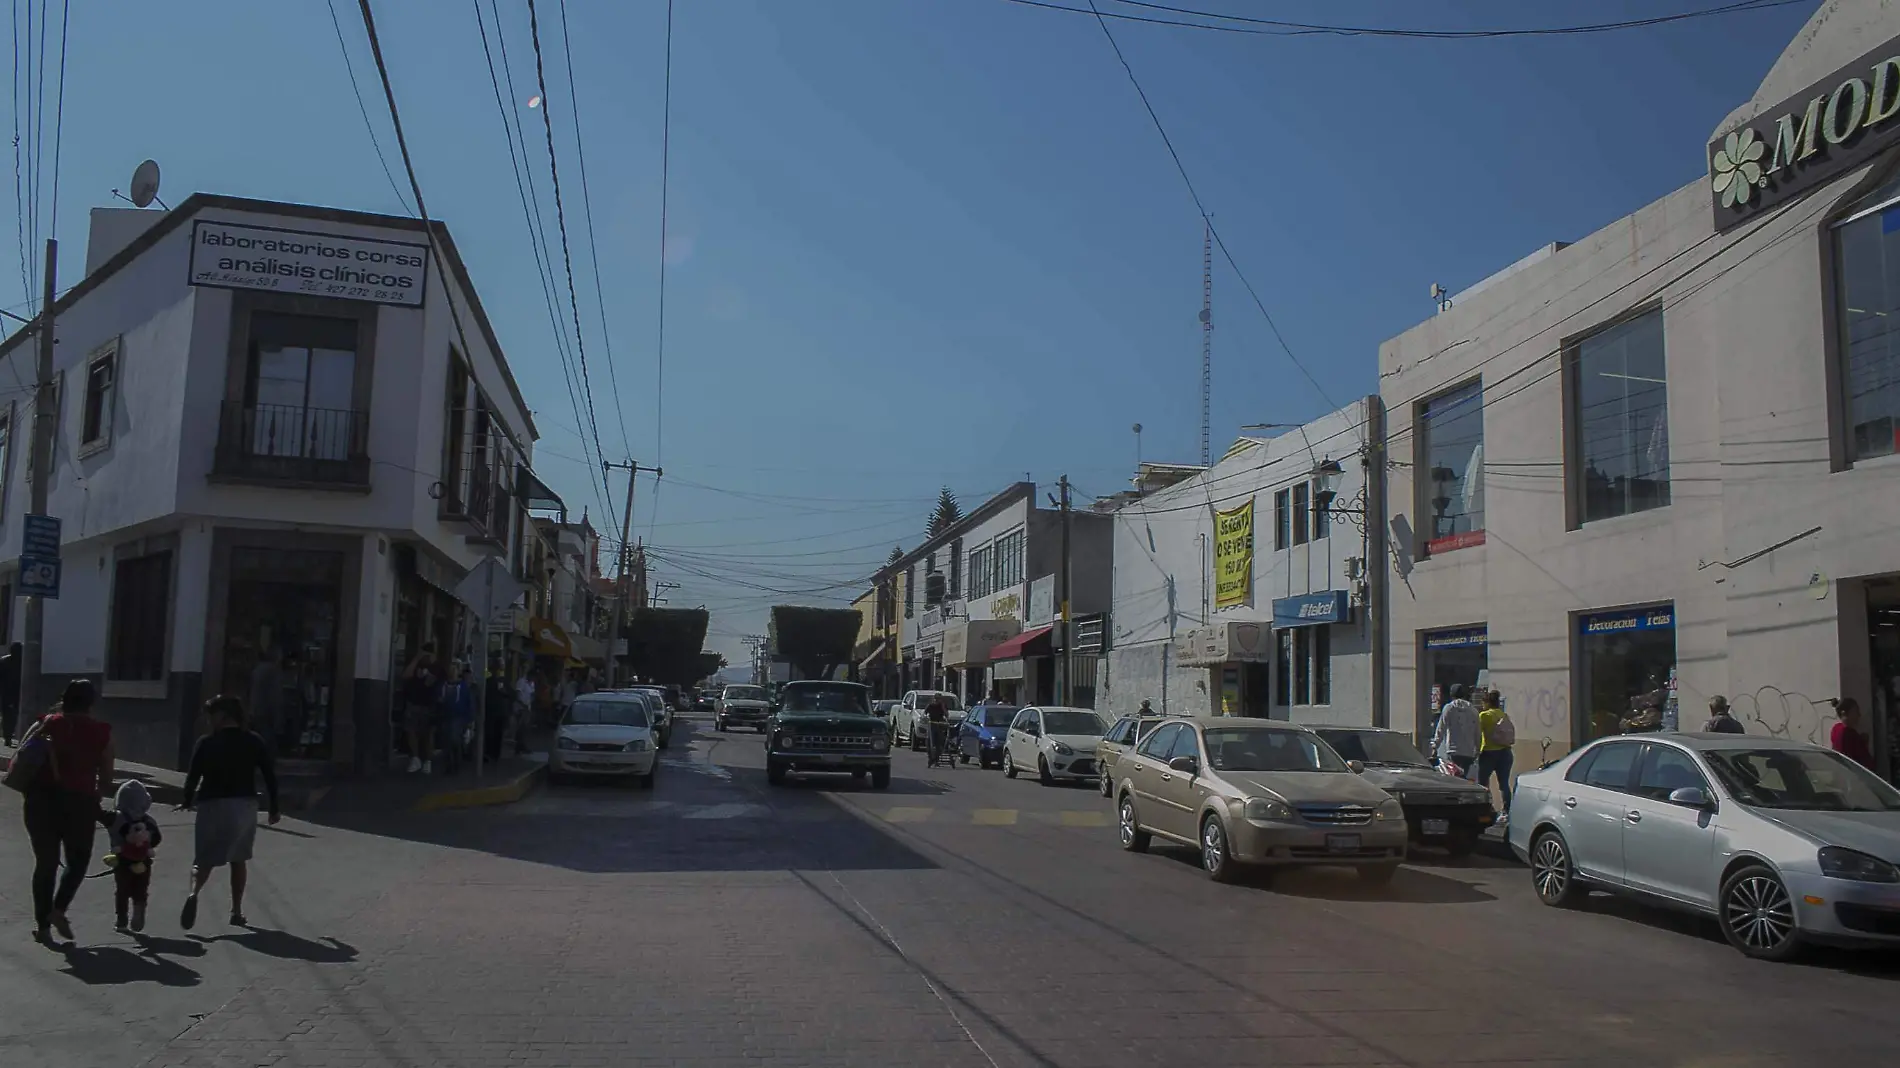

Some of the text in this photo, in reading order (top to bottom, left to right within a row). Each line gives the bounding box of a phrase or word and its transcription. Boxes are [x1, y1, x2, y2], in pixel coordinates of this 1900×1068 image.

[201, 230, 423, 268] laboratorios corsa
[218, 256, 316, 279] análisis
[319, 265, 413, 289] clínicos
[325, 284, 346, 295] 427
[348, 287, 370, 297] 272
[1220, 519, 1229, 535] SE
[1223, 540, 1231, 556] SE
[1307, 600, 1334, 617] telcel
